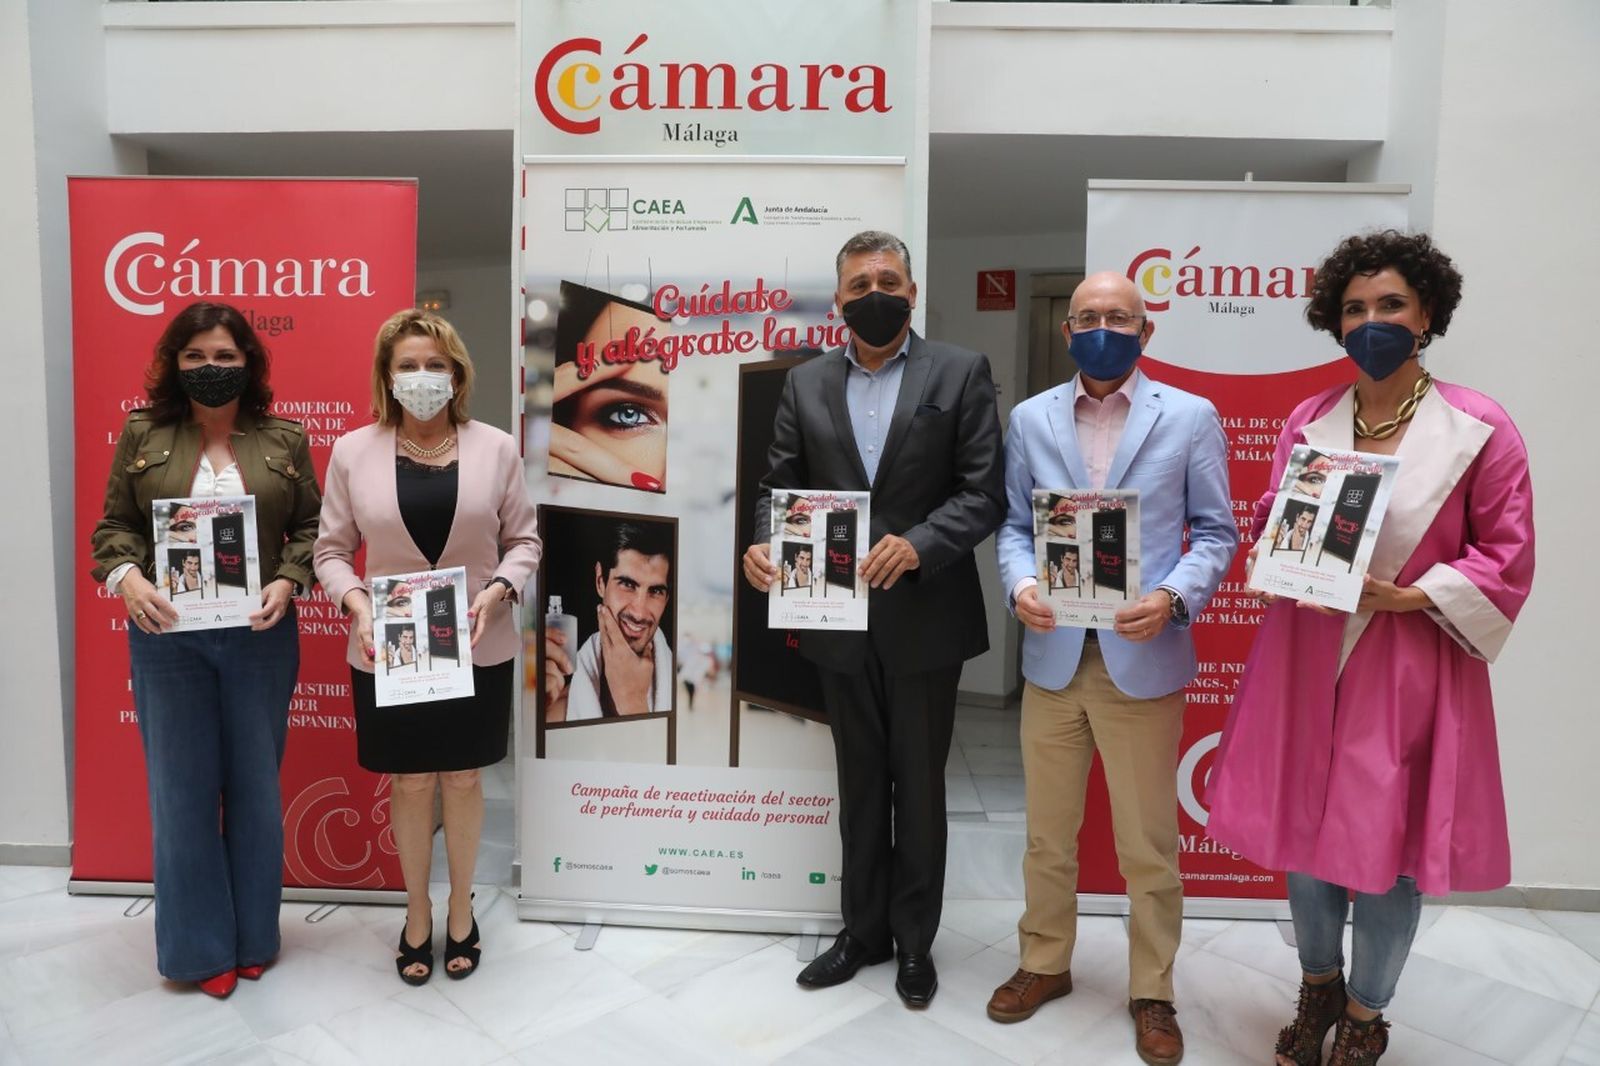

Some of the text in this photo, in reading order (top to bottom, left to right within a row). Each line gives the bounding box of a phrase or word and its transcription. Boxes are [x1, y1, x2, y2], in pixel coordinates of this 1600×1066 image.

[663, 123, 738, 147] Málaga
[632, 199, 686, 215] CAEA
[654, 278, 792, 320] Cuídate
[1208, 301, 1255, 317] Málaga
[241, 309, 294, 337] laga
[575, 340, 598, 379] y
[603, 319, 759, 373] alégrate
[760, 317, 802, 351] la
[325, 417, 346, 431] DE
[1249, 418, 1269, 429] DE
[1212, 597, 1231, 608] DE
[1196, 613, 1215, 623] DE
[571, 783, 834, 807] Campaña de reactivación del sector
[580, 800, 830, 826] de perfumería y cuidado personal
[658, 847, 744, 859] WWW.CAEA.ES
